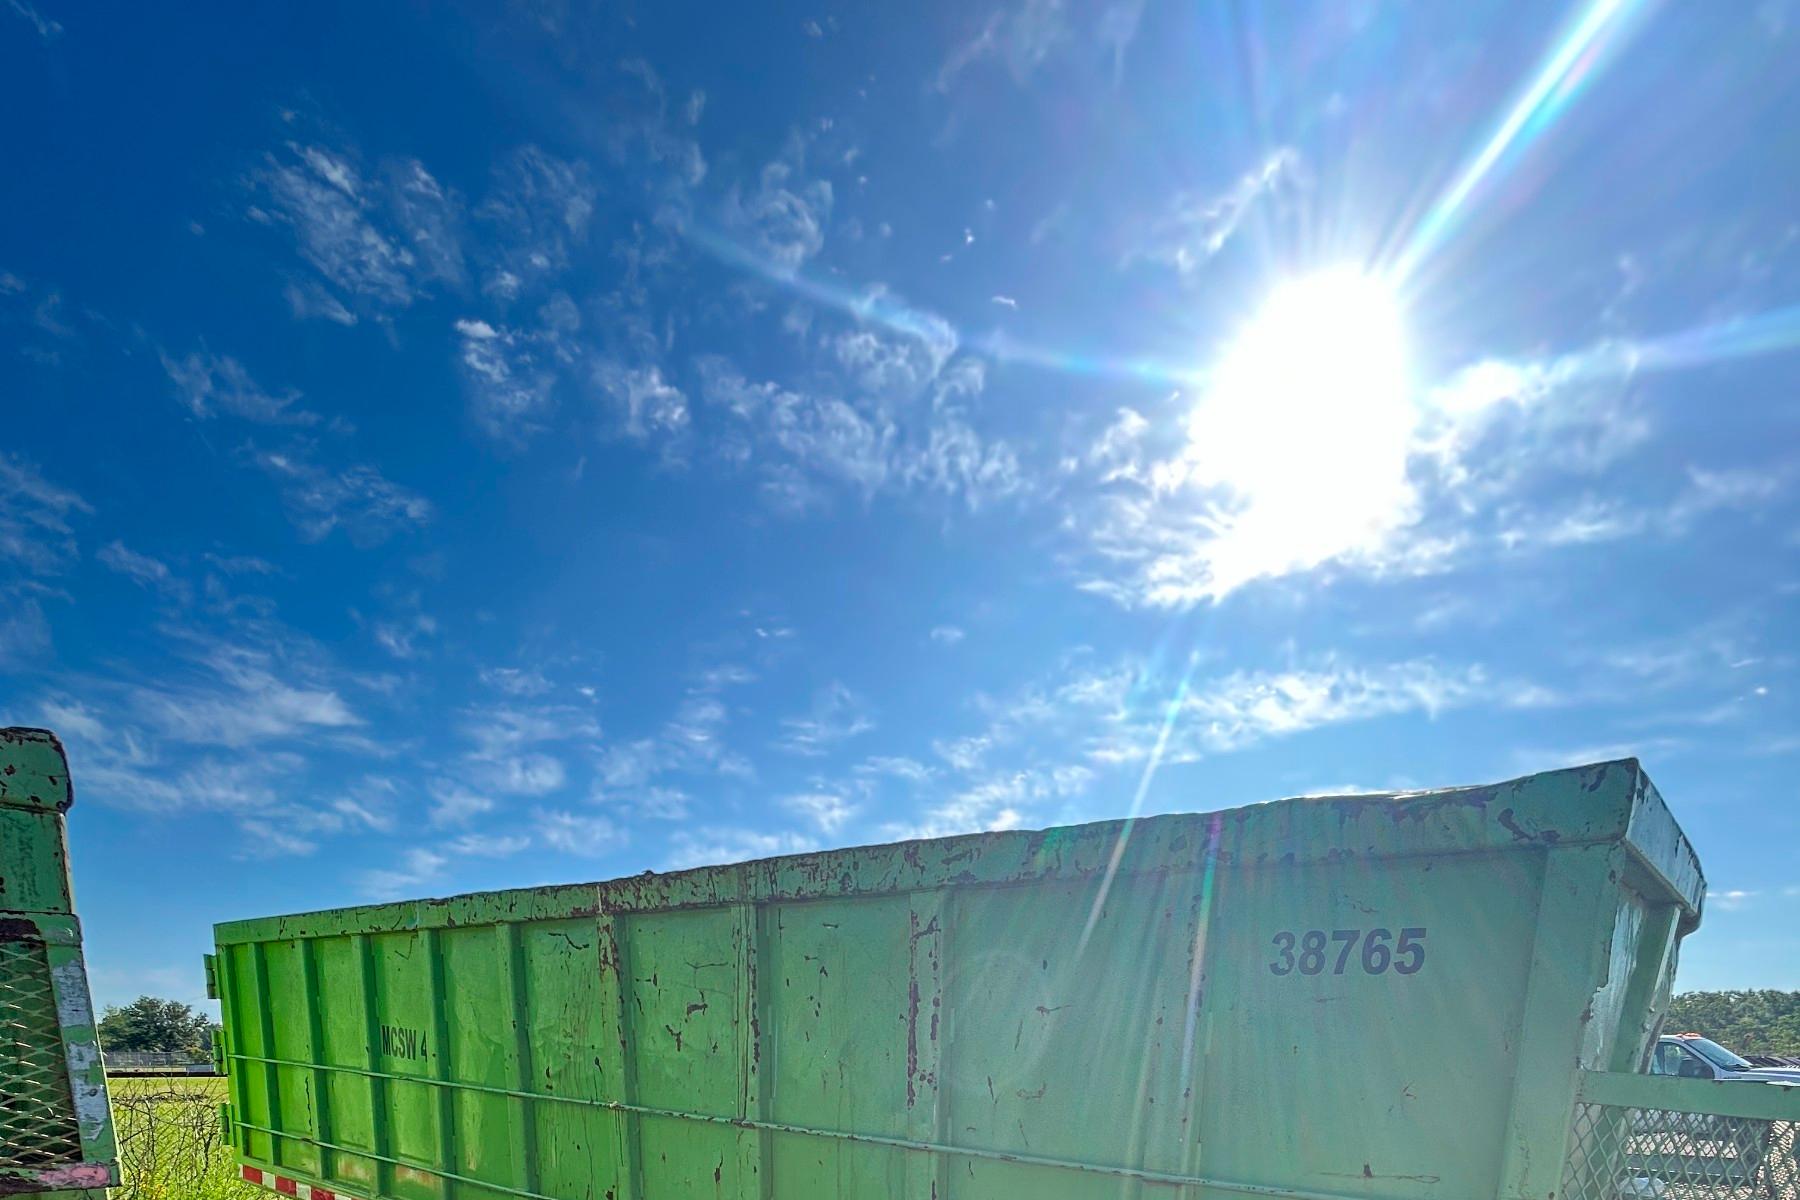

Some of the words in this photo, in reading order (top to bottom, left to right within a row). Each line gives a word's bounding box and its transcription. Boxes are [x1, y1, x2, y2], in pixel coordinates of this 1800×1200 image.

[1269, 928, 1427, 976] 38765
[381, 1025, 417, 1061] MCSW
[420, 1030, 428, 1063] 4
